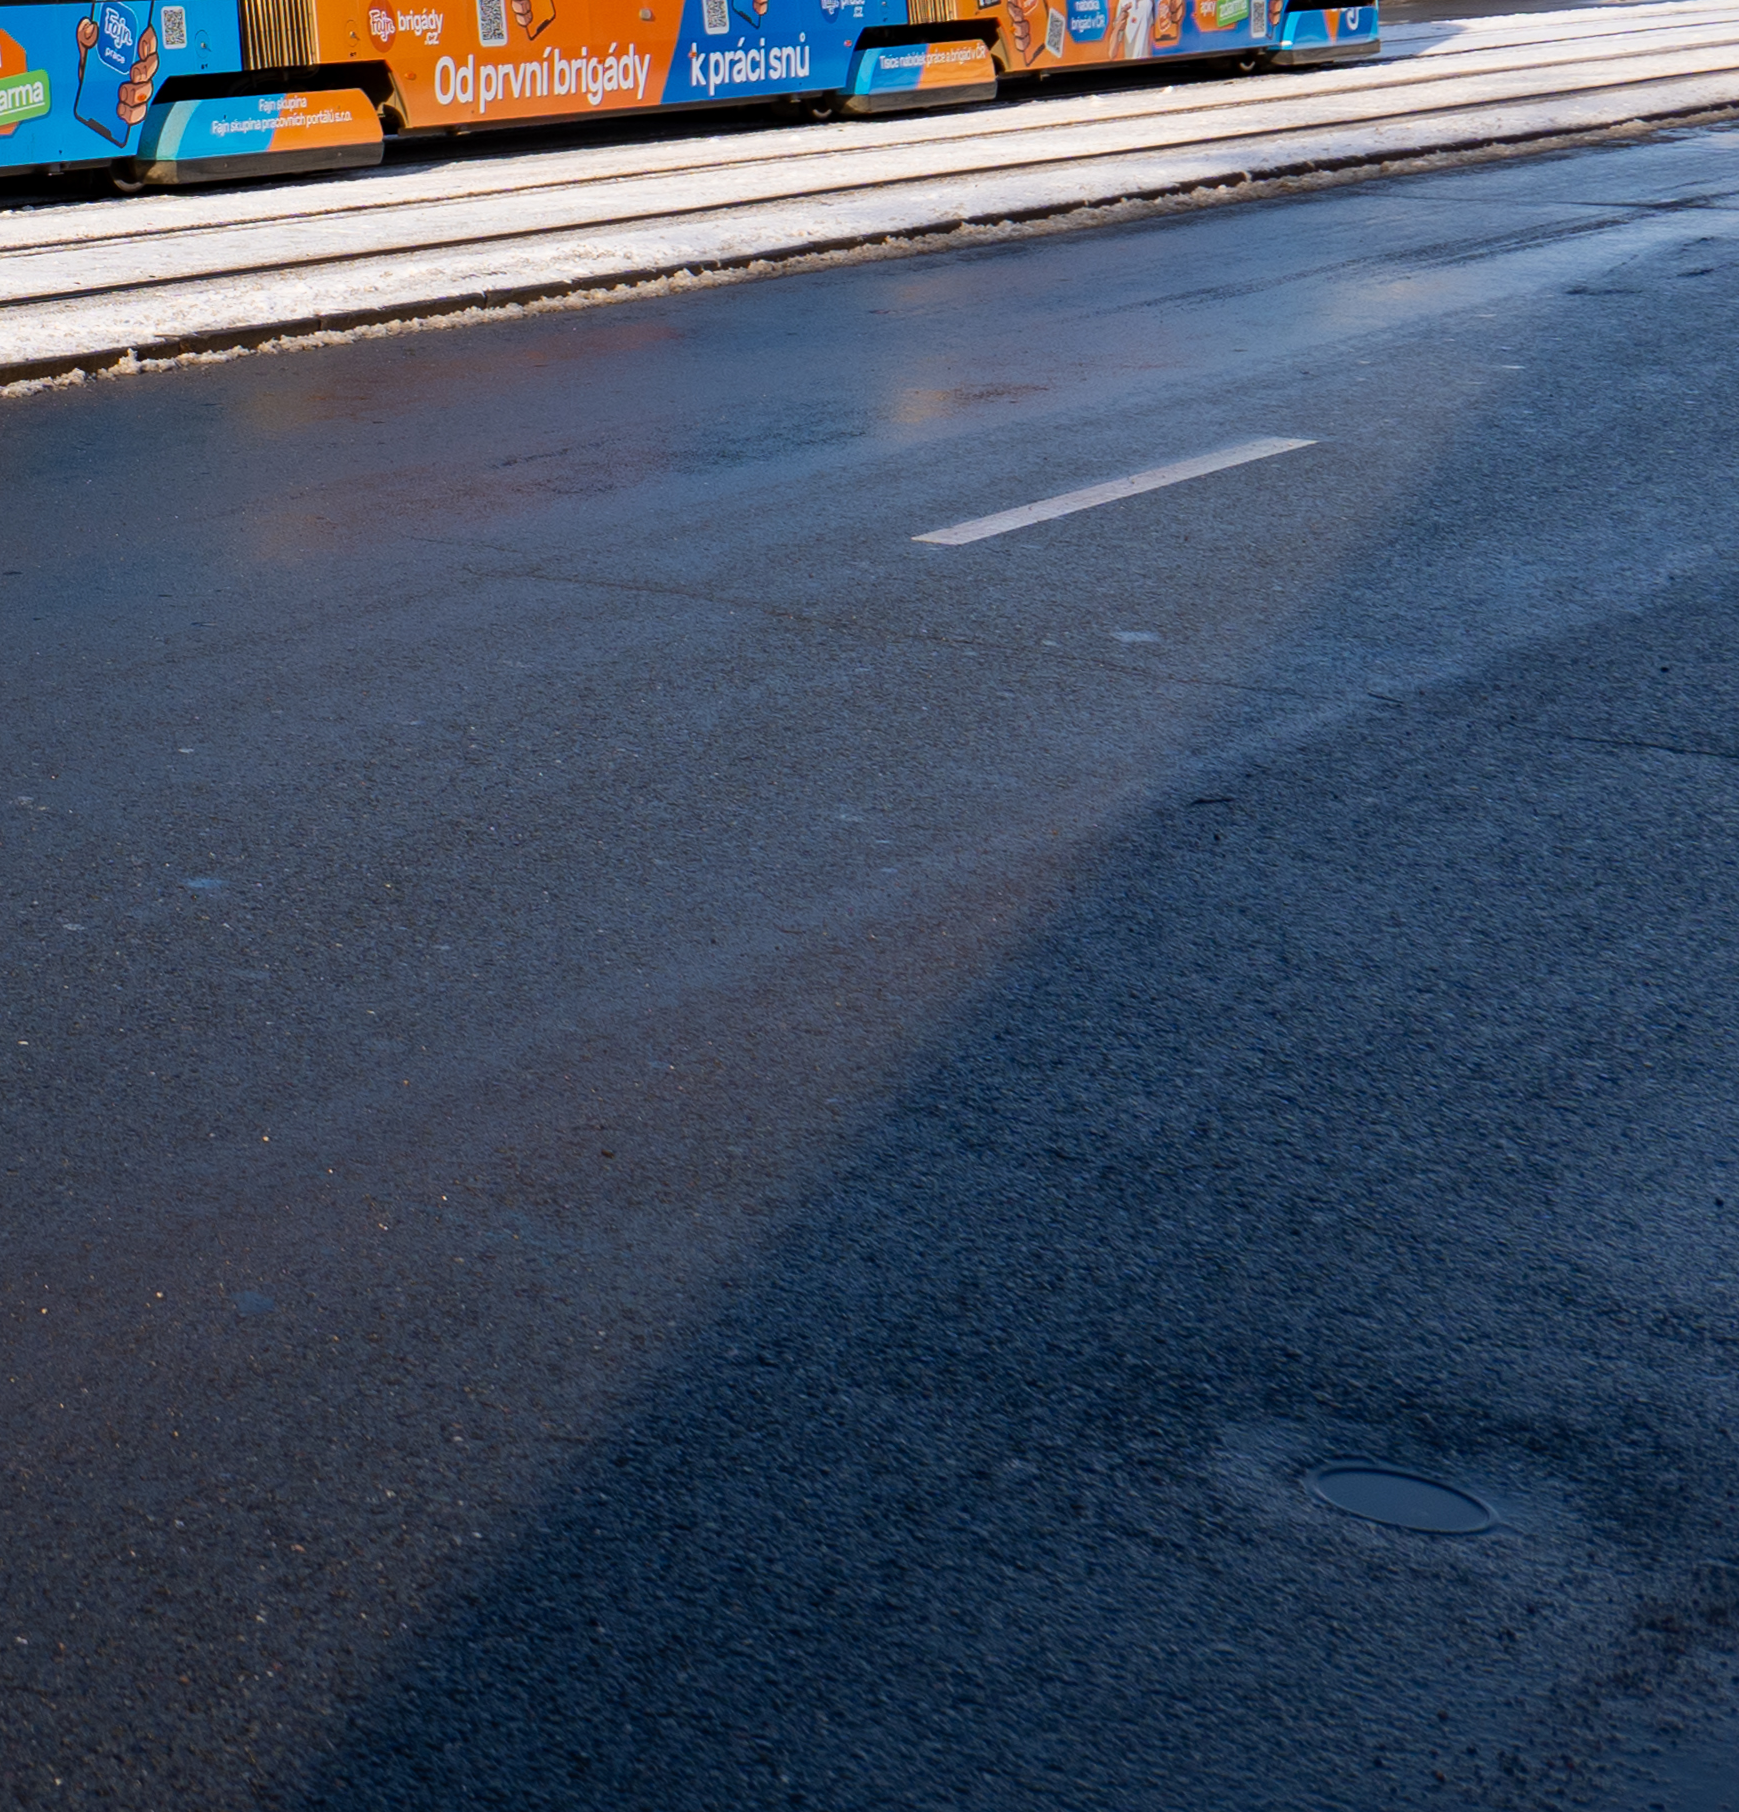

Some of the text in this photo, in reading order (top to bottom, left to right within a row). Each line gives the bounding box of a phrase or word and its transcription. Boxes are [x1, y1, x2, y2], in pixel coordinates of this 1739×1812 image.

[104, 7, 133, 49] Fajn
[397, 8, 443, 36] brigády
[435, 43, 650, 113] Od první brigády
[691, 33, 810, 95] k práci snů
[258, 96, 307, 114] Fajn skupina
